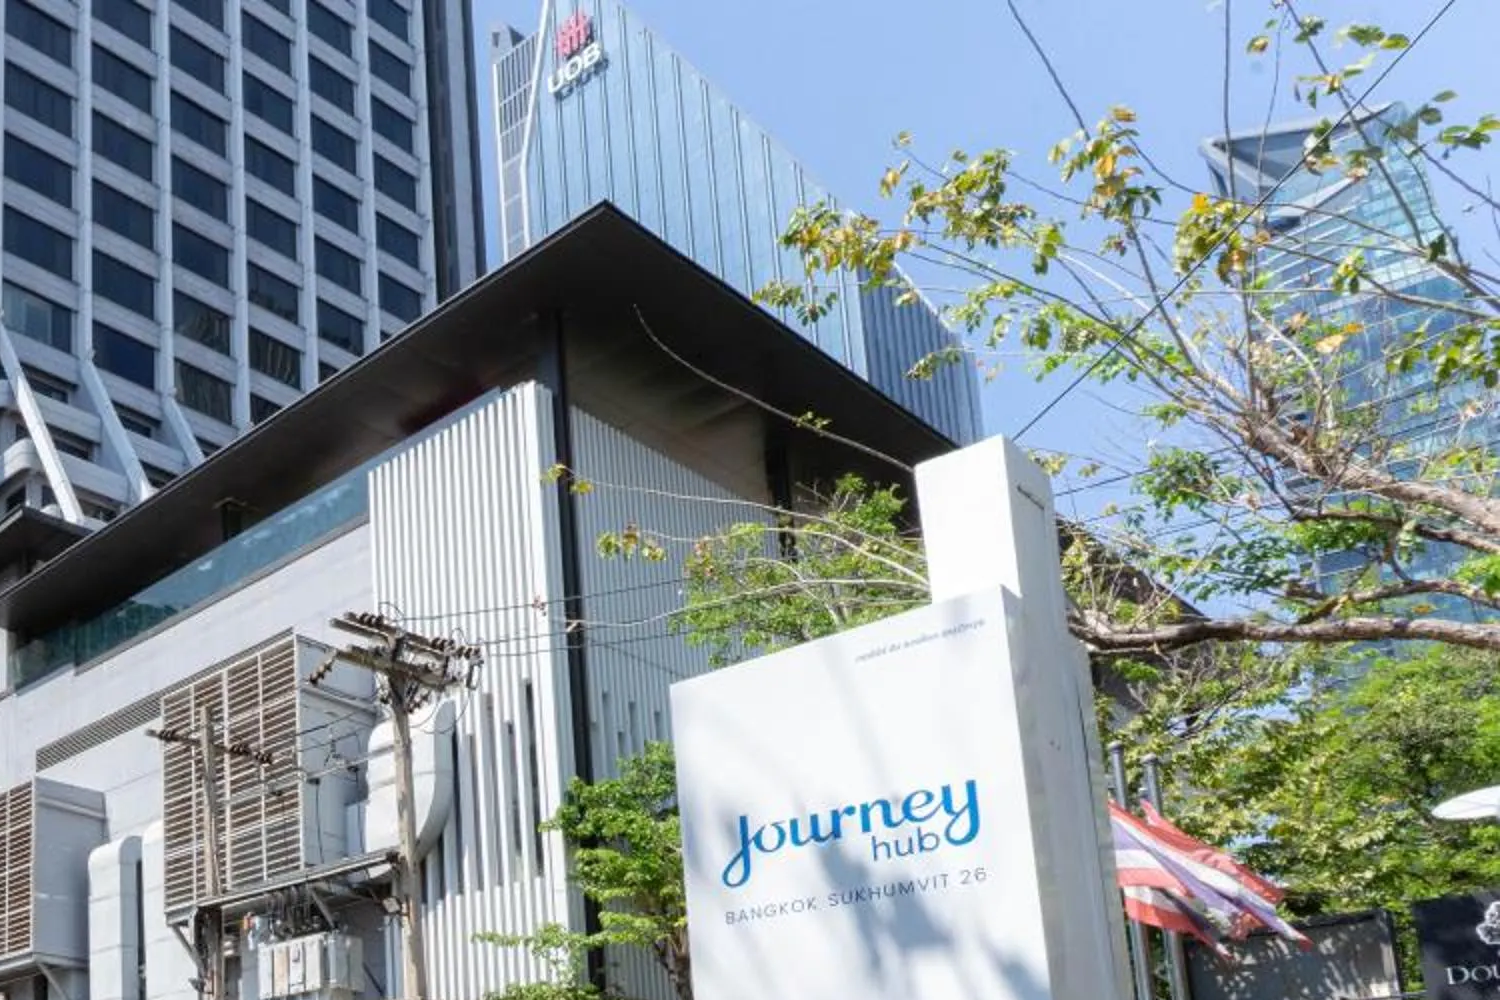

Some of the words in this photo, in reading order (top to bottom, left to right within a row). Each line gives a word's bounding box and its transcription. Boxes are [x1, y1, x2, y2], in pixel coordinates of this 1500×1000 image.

[547, 40, 602, 93] UOB
[871, 825, 941, 862] hub
[724, 896, 818, 926] BANGKOK
[828, 872, 951, 908] SUKHUMVIT
[959, 866, 988, 886] 26
